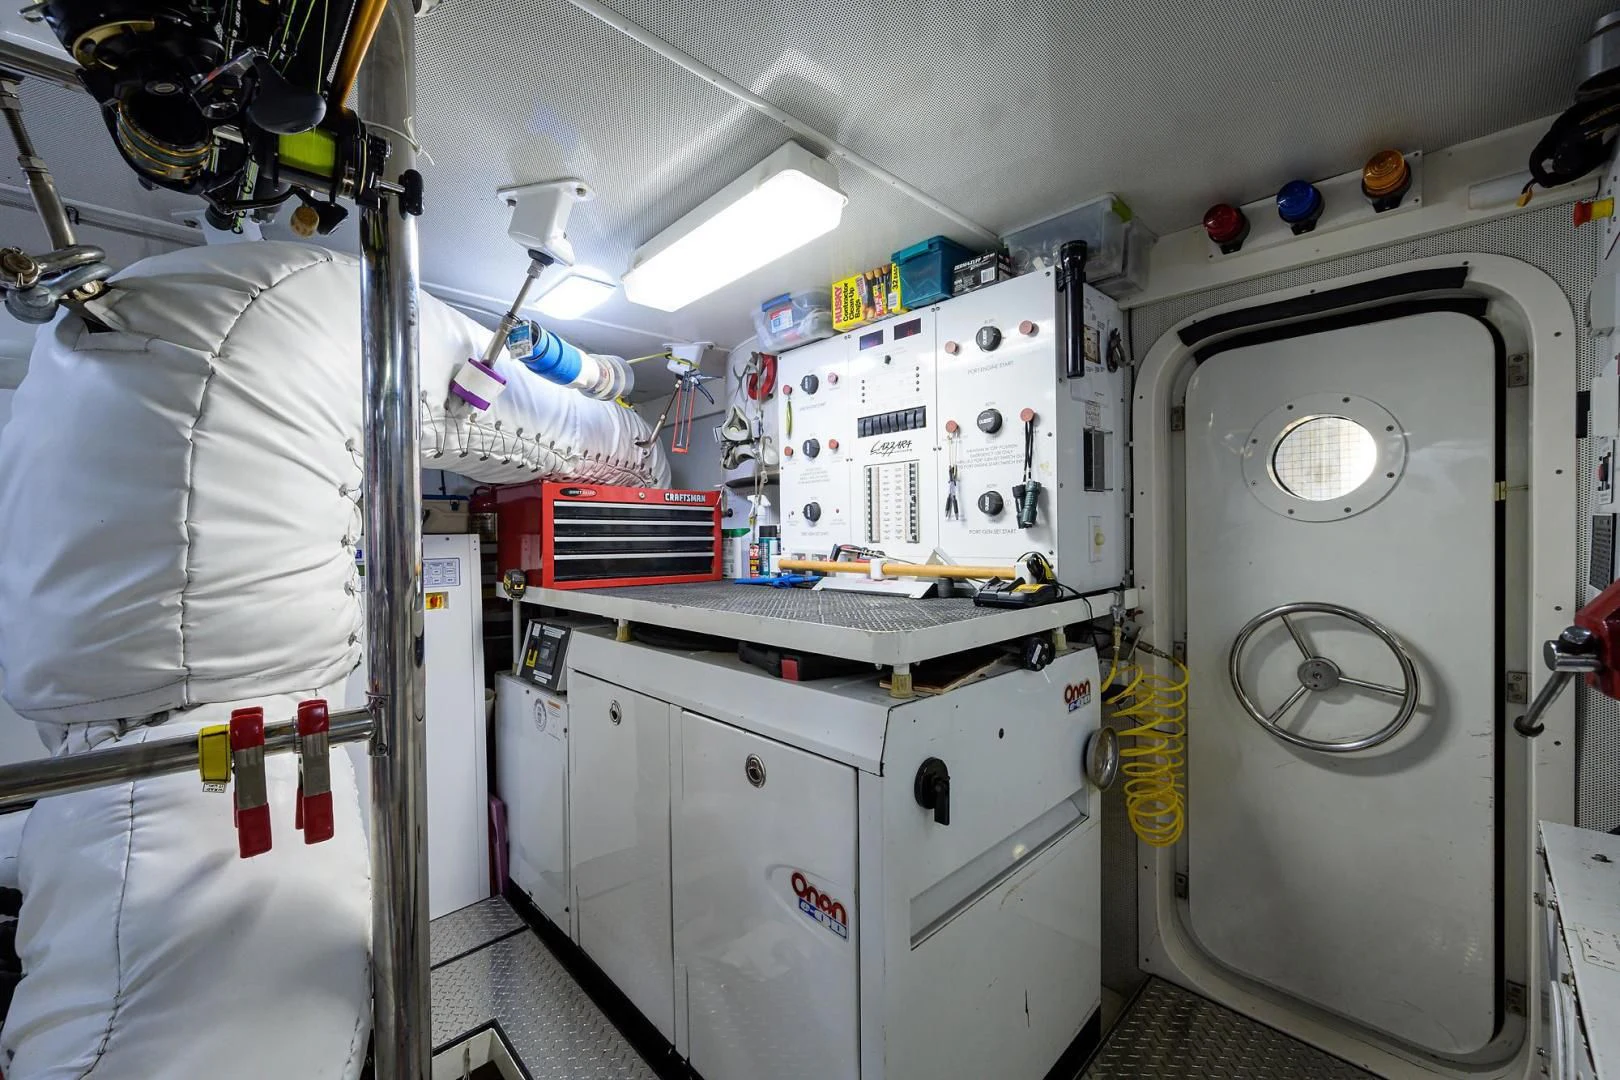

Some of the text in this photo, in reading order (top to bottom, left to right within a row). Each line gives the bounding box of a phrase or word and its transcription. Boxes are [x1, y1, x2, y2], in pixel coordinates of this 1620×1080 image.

[892, 279, 898, 290] 32
[834, 286, 842, 324] HUSKY
[664, 492, 706, 502] CRAFTSMAN
[1064, 680, 1091, 704] Onan
[791, 872, 847, 926] Onan
